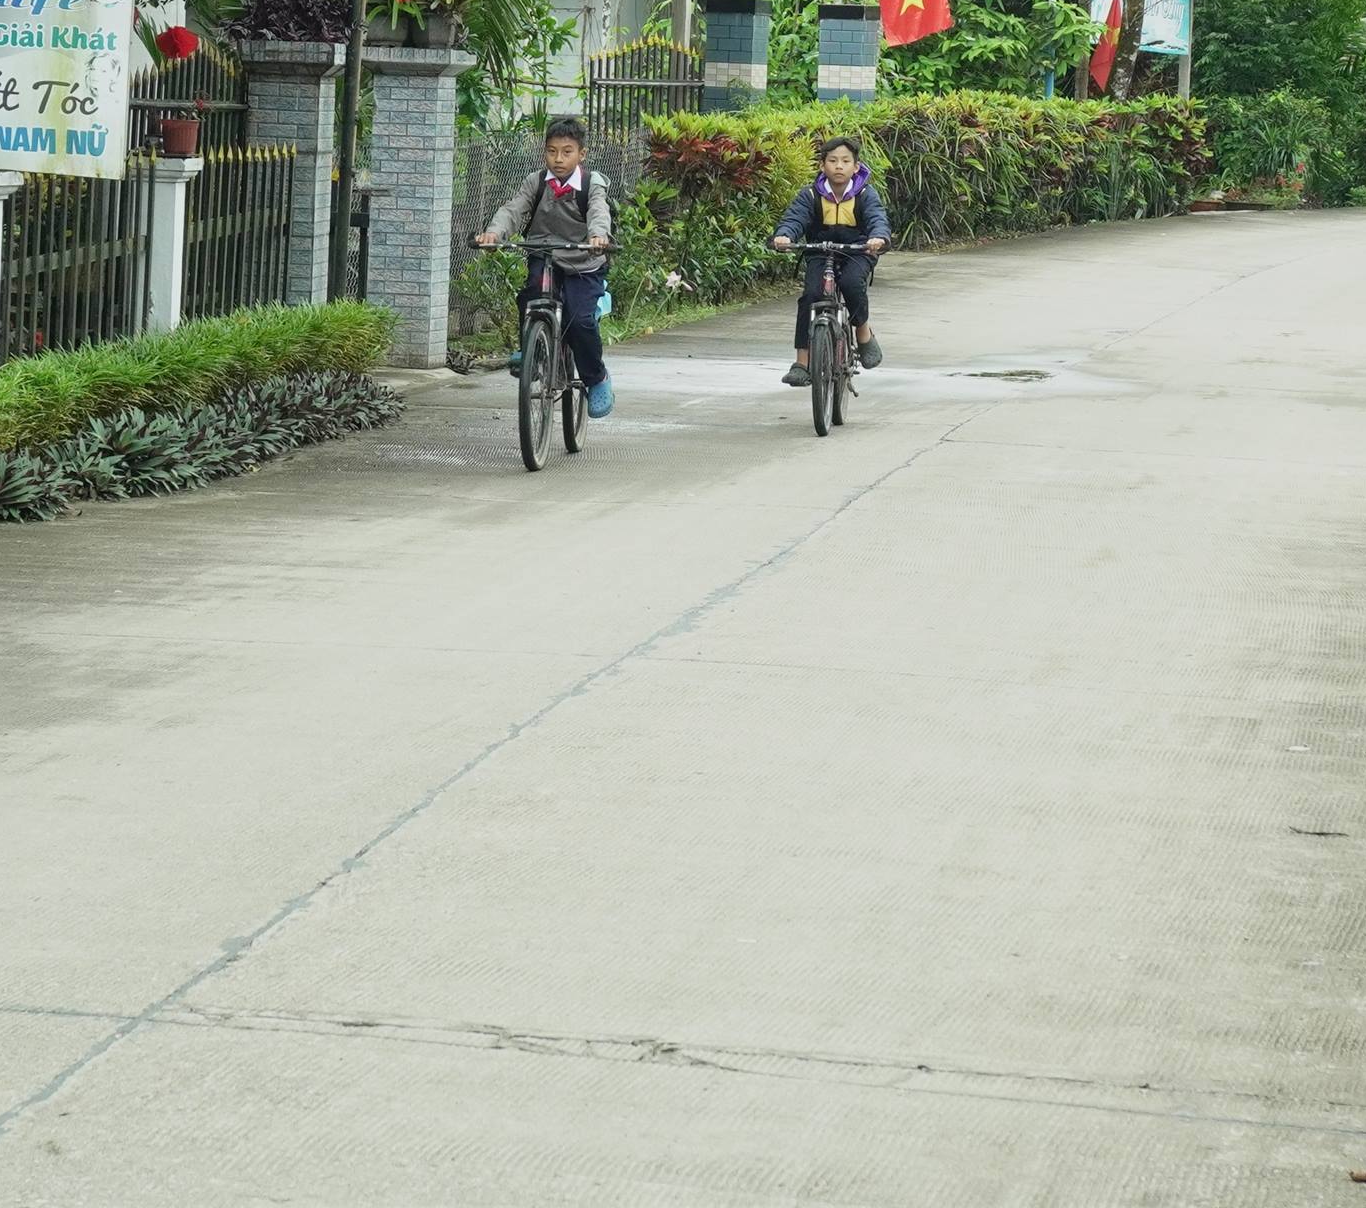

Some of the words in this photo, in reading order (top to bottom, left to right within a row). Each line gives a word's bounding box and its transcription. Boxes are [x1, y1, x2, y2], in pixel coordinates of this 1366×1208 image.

[51, 26, 117, 51] Khát
[32, 80, 98, 115] Tóc
[66, 124, 108, 156] NỮ
